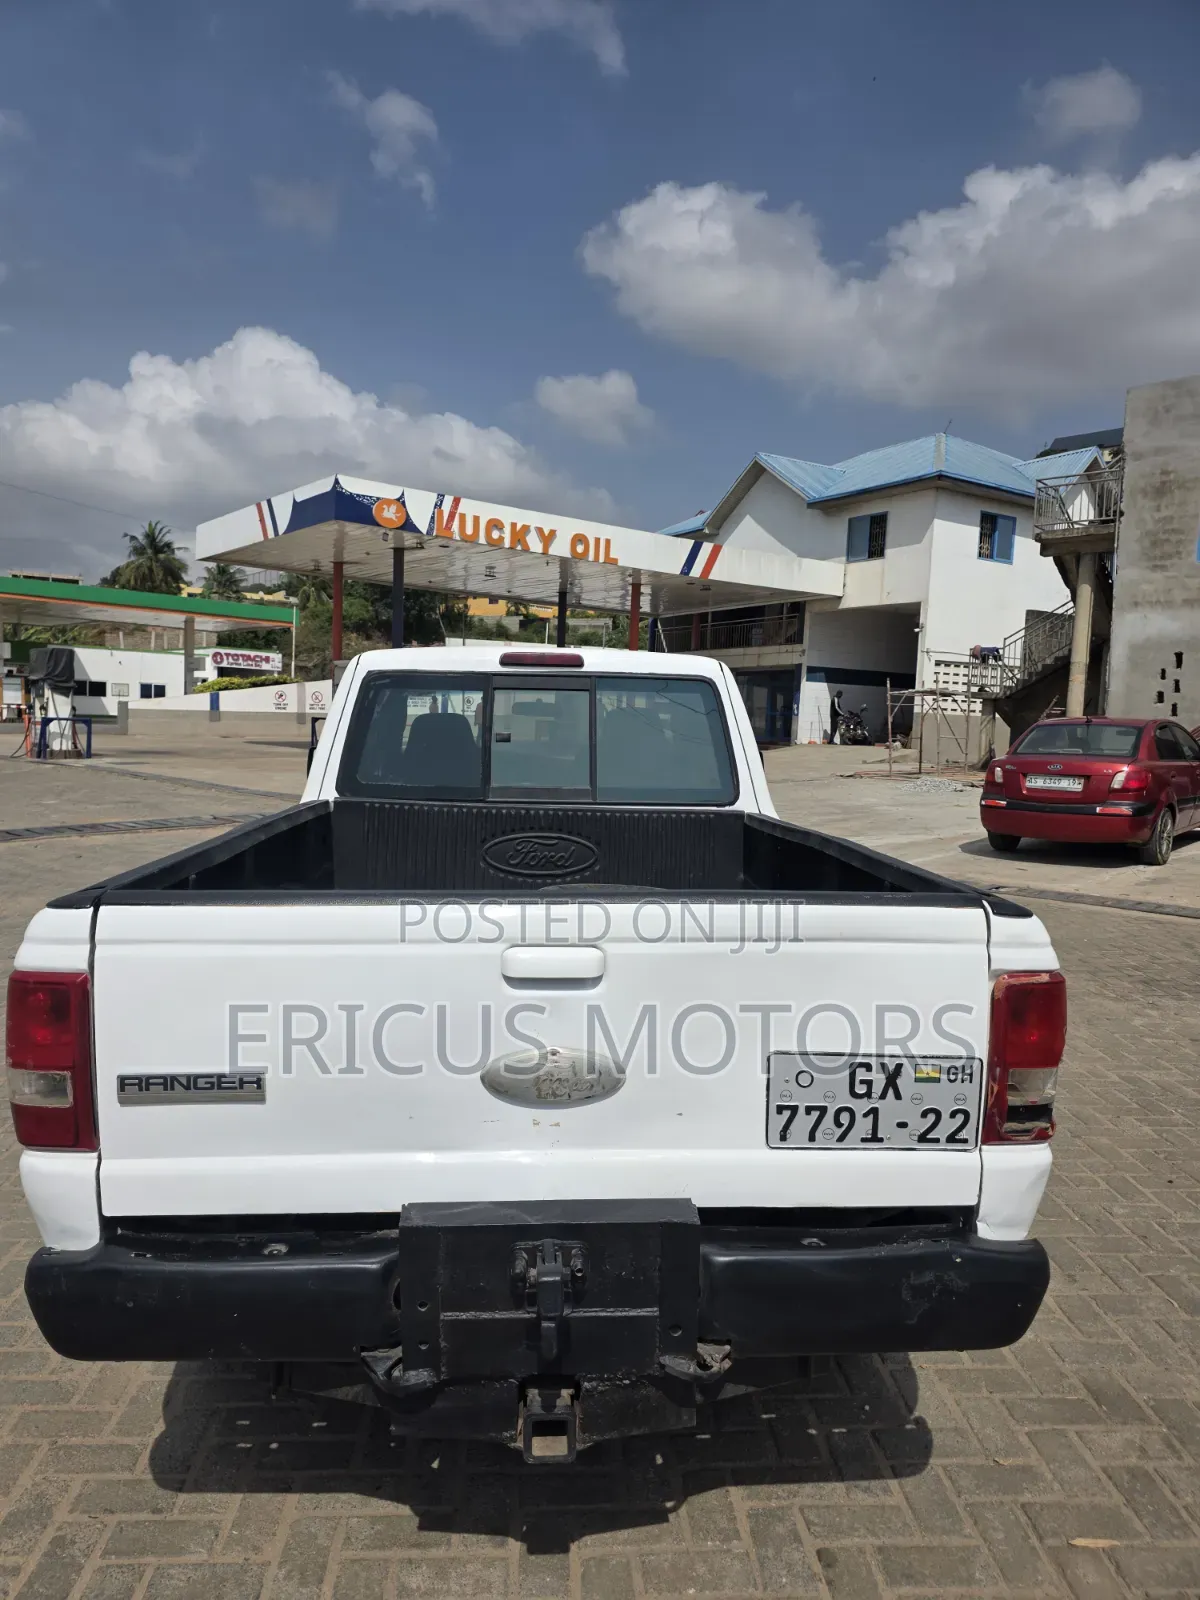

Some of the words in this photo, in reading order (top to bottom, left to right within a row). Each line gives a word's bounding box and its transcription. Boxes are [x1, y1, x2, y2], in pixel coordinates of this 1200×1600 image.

[435, 508, 557, 555] LUCKY
[570, 532, 618, 565] OIL
[224, 652, 271, 664] TOTACHI
[507, 839, 576, 867] Ford
[119, 1075, 262, 1092] RANGER
[849, 1061, 904, 1101] GX
[946, 1064, 973, 1084] GH
[776, 1104, 971, 1144] 7791-22
